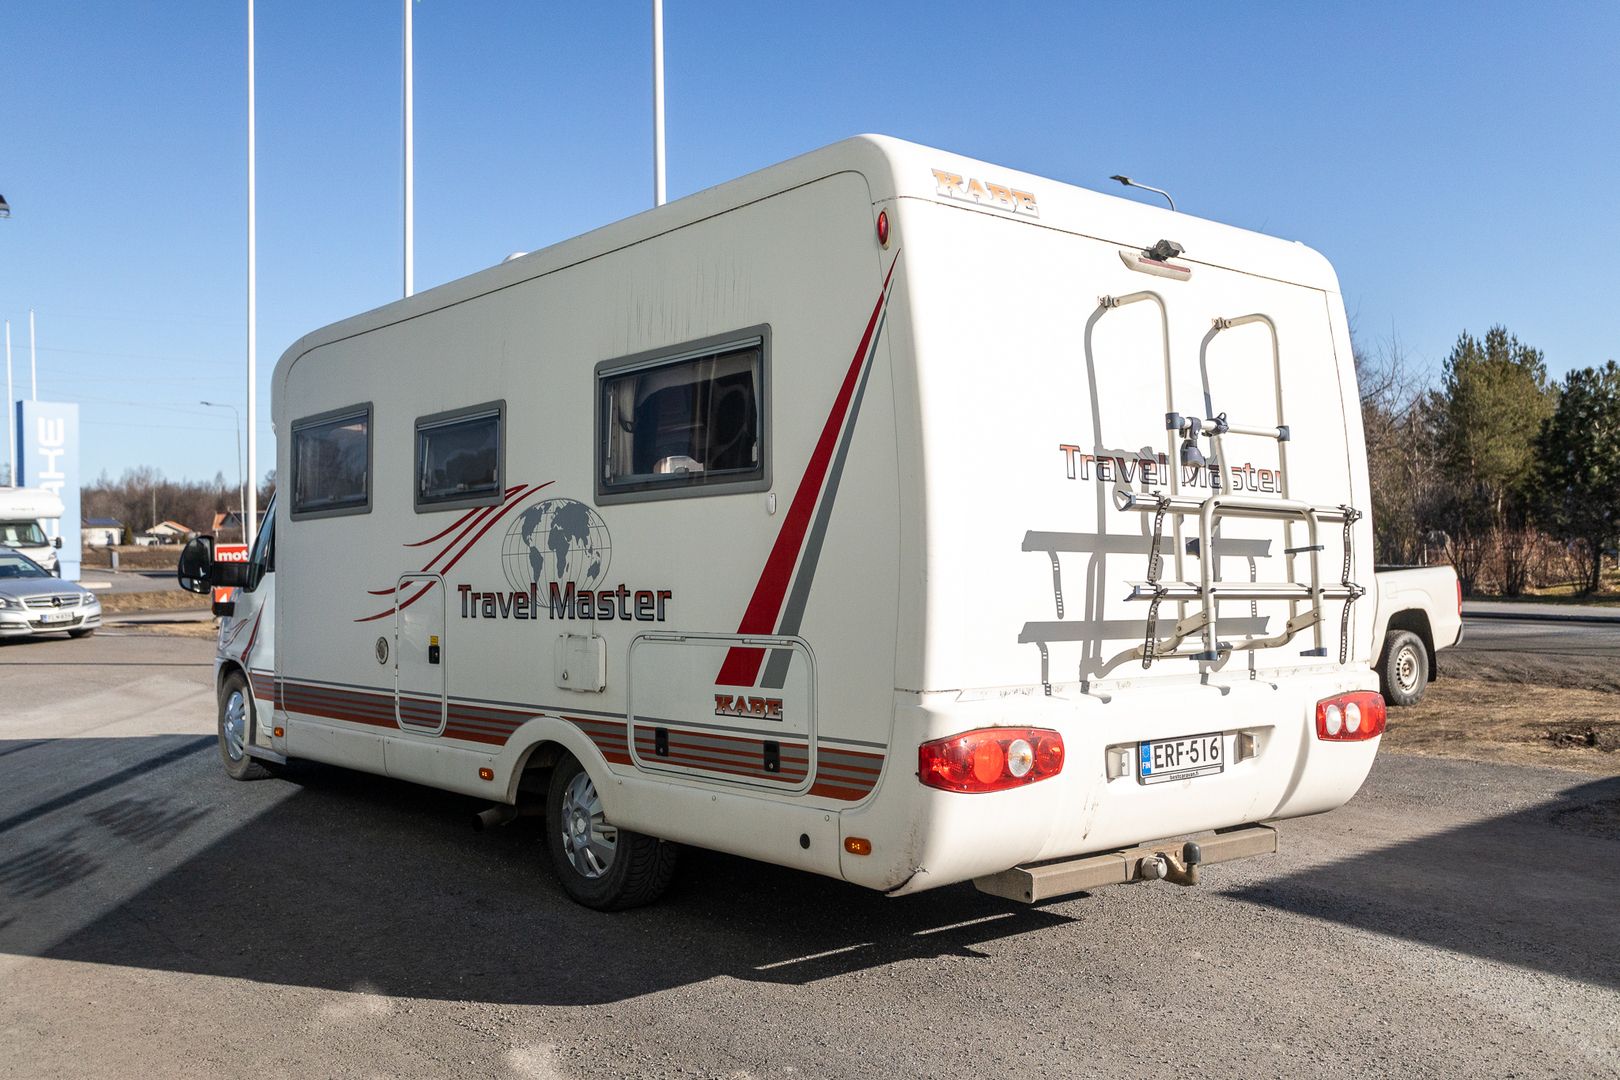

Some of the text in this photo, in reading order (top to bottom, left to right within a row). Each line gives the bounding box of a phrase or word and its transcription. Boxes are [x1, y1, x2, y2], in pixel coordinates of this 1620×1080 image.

[931, 168, 1040, 219] KABE
[1060, 444, 1168, 486] Travel
[458, 581, 672, 621] Travel Master
[715, 694, 783, 721] KABE
[1154, 737, 1219, 769] ERF-516
